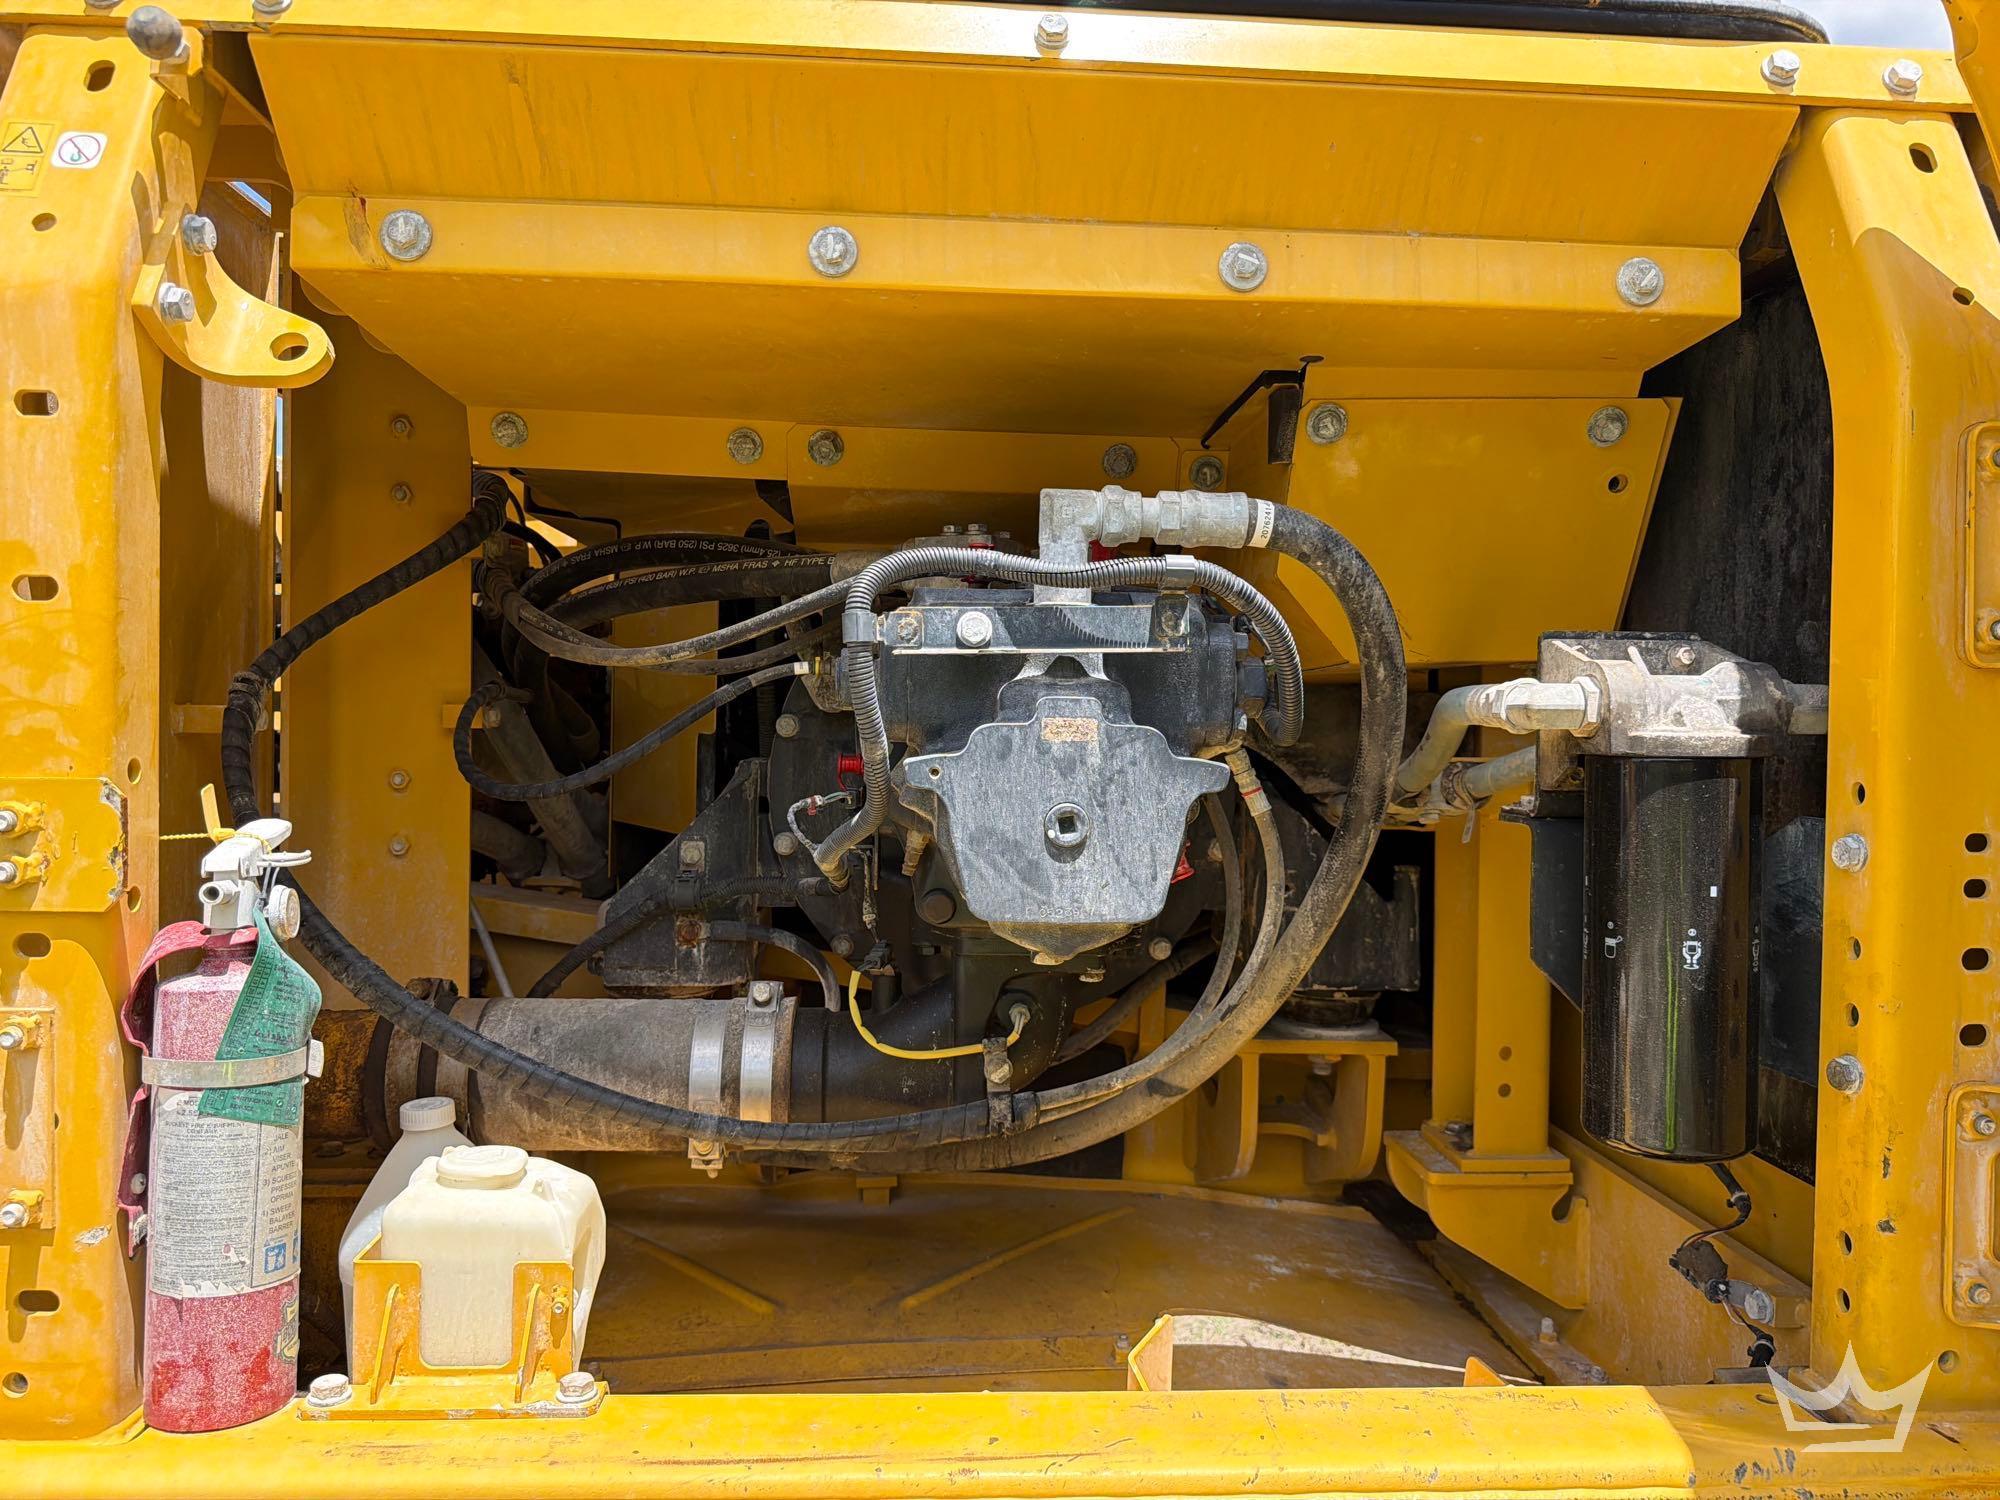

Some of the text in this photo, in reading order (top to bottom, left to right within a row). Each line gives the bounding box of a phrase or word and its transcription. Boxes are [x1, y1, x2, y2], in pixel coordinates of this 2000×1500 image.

[654, 539, 677, 549] BAR)
[677, 539, 697, 549] (250
[698, 540, 715, 549] PSI
[717, 542, 739, 552] 3625
[594, 544, 618, 557] MSHA
[655, 570, 677, 580] BAR)
[712, 562, 739, 573] MSHA
[742, 560, 769, 570] FRAS
[784, 559, 798, 567] HF
[800, 557, 826, 566] TYPE
